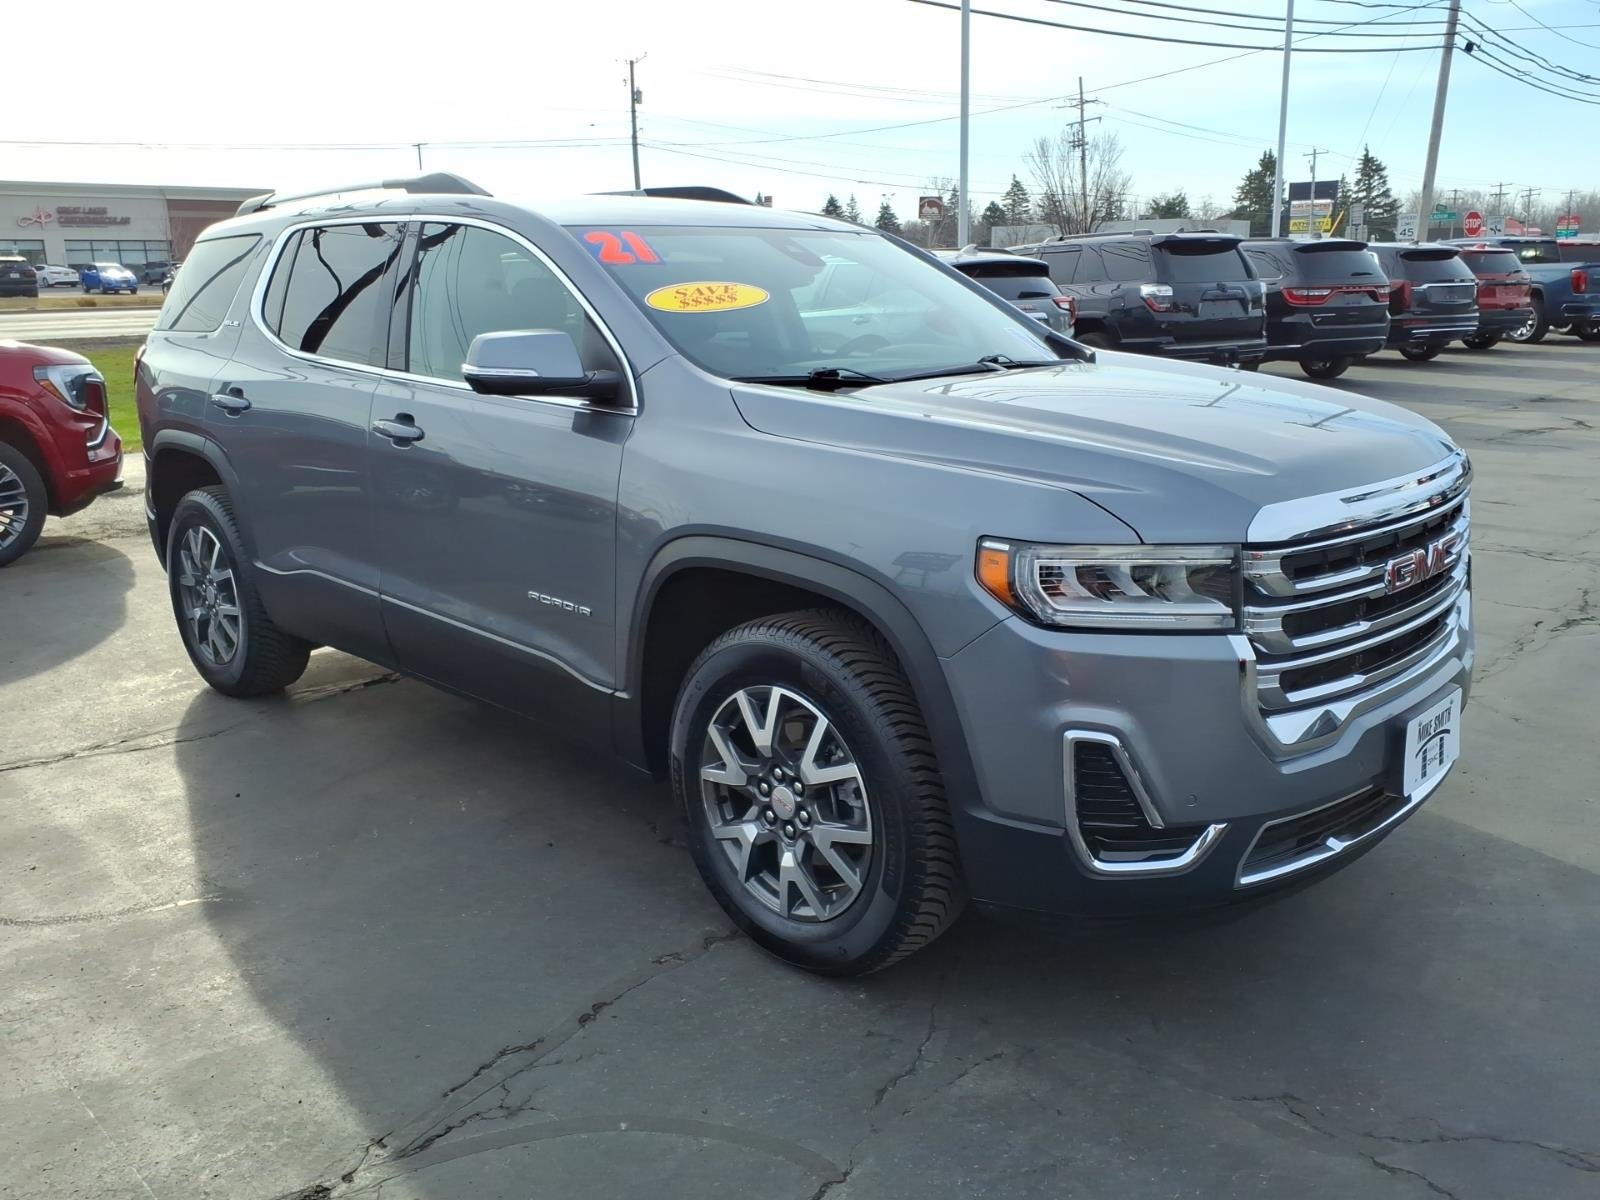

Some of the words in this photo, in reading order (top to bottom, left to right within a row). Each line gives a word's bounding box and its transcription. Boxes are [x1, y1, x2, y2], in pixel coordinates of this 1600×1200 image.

[1399, 228, 1414, 237] 45
[1465, 218, 1482, 229] STOP
[584, 231, 661, 263] 21
[674, 285, 738, 299] SAVE
[1386, 540, 1458, 595] GMC
[527, 591, 592, 616] ACADIA
